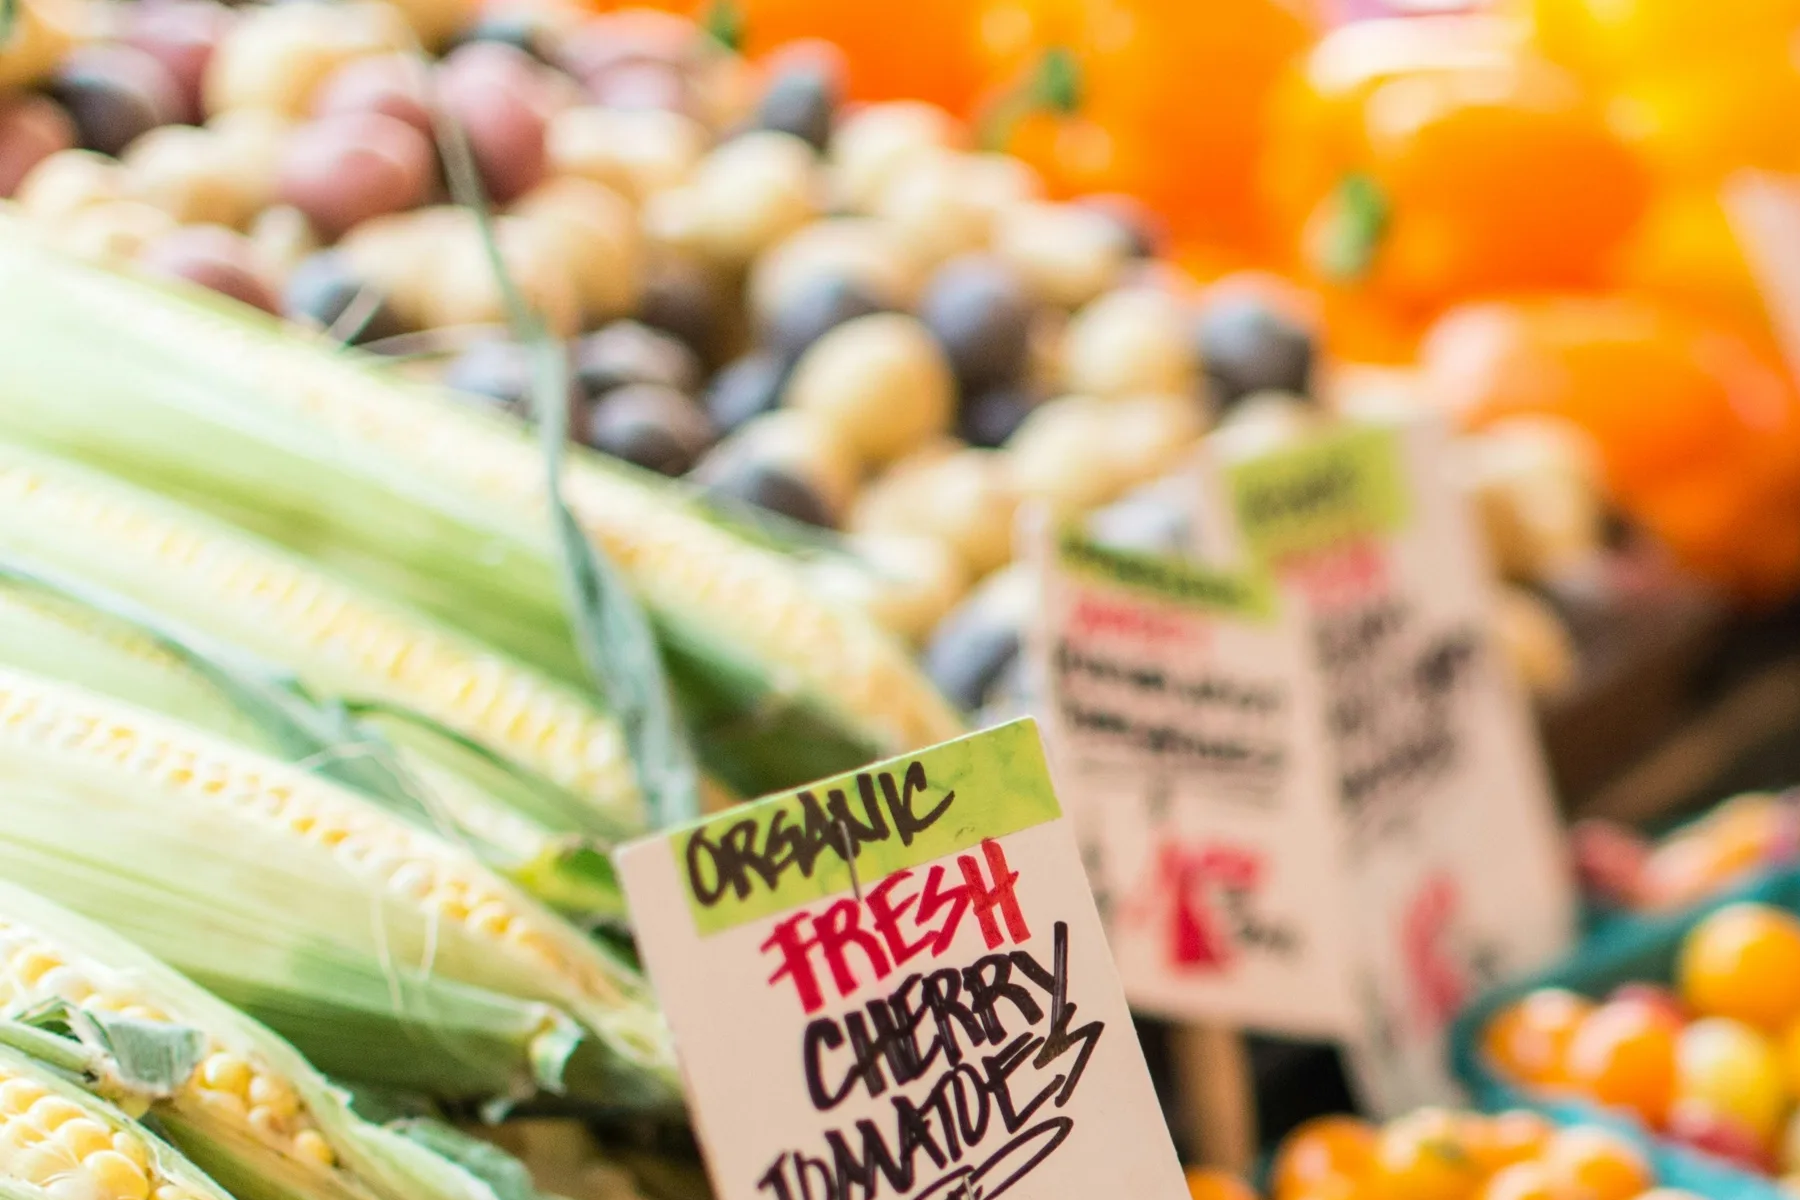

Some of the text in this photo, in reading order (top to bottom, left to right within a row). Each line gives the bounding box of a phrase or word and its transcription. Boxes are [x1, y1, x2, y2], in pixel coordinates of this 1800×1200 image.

[686, 761, 955, 907] ORGANIC
[759, 837, 1032, 1014] FRESH
[803, 921, 1072, 1111] CHERRY
